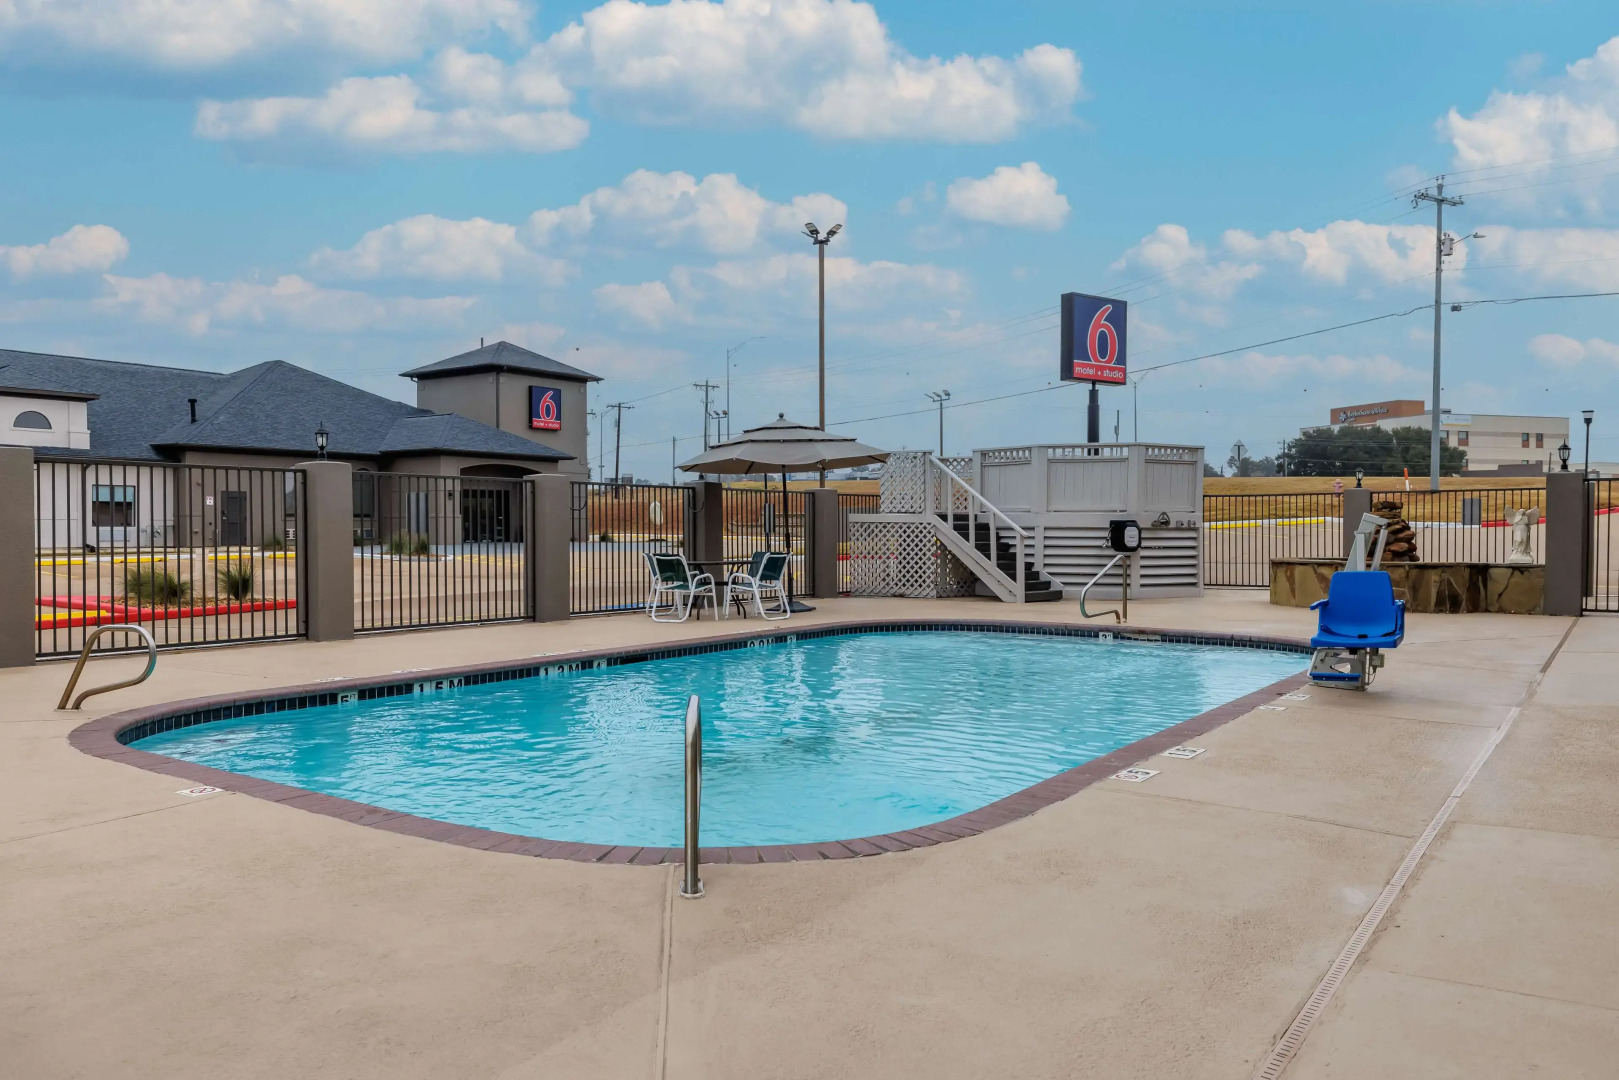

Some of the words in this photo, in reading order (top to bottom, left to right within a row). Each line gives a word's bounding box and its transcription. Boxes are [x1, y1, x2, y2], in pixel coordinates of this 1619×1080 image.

[1087, 304, 1118, 365] 6
[1075, 366, 1096, 375] motel
[1103, 368, 1124, 379] studio
[540, 390, 557, 421] 6
